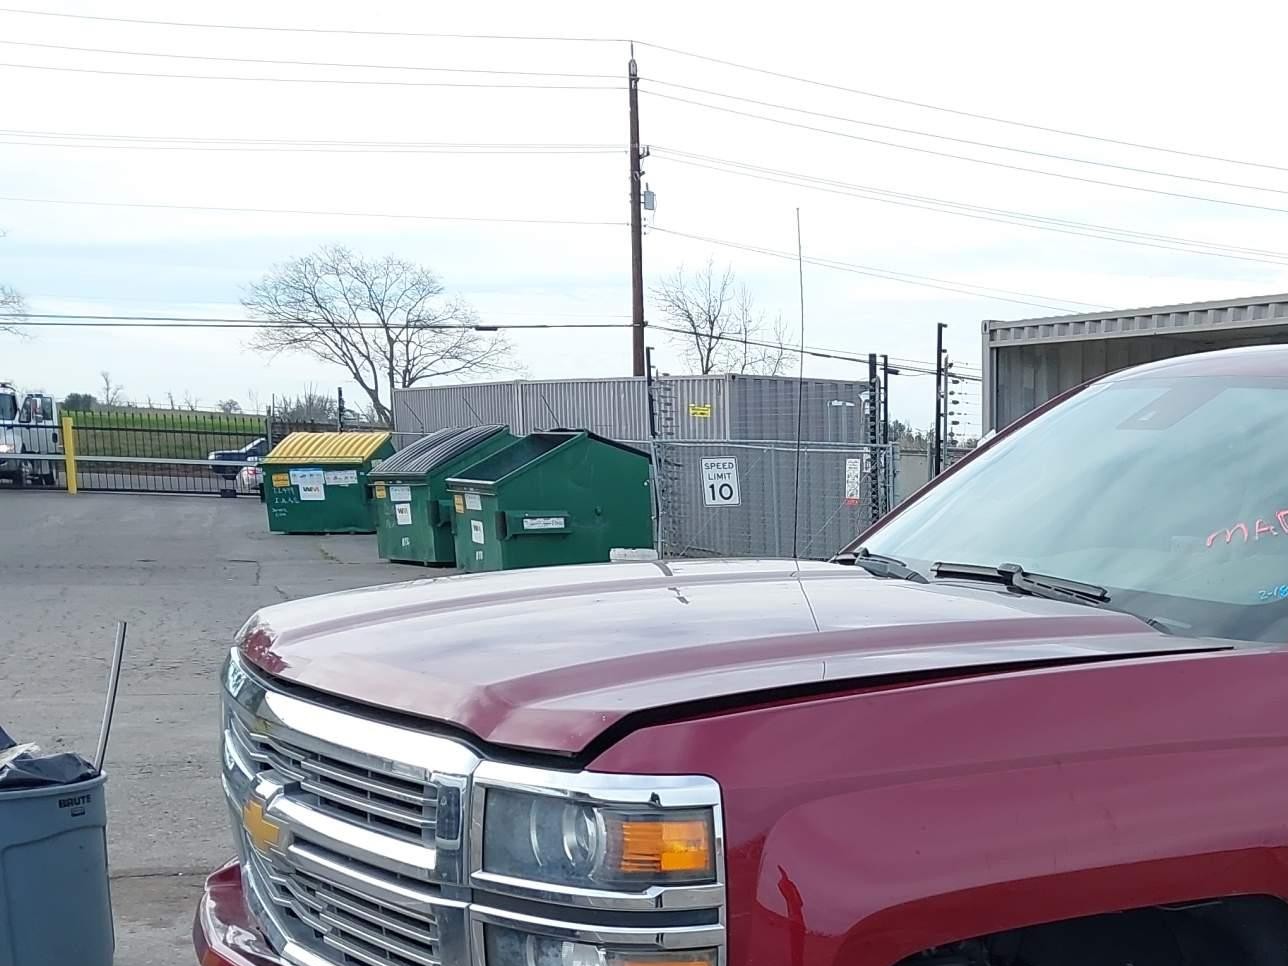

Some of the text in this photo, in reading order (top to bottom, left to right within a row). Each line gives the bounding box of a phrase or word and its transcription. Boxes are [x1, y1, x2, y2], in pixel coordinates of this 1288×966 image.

[703, 462, 734, 470] SPEED
[708, 472, 732, 481] LIMIT
[708, 484, 734, 501] 10
[58, 794, 92, 809] BRUTE
